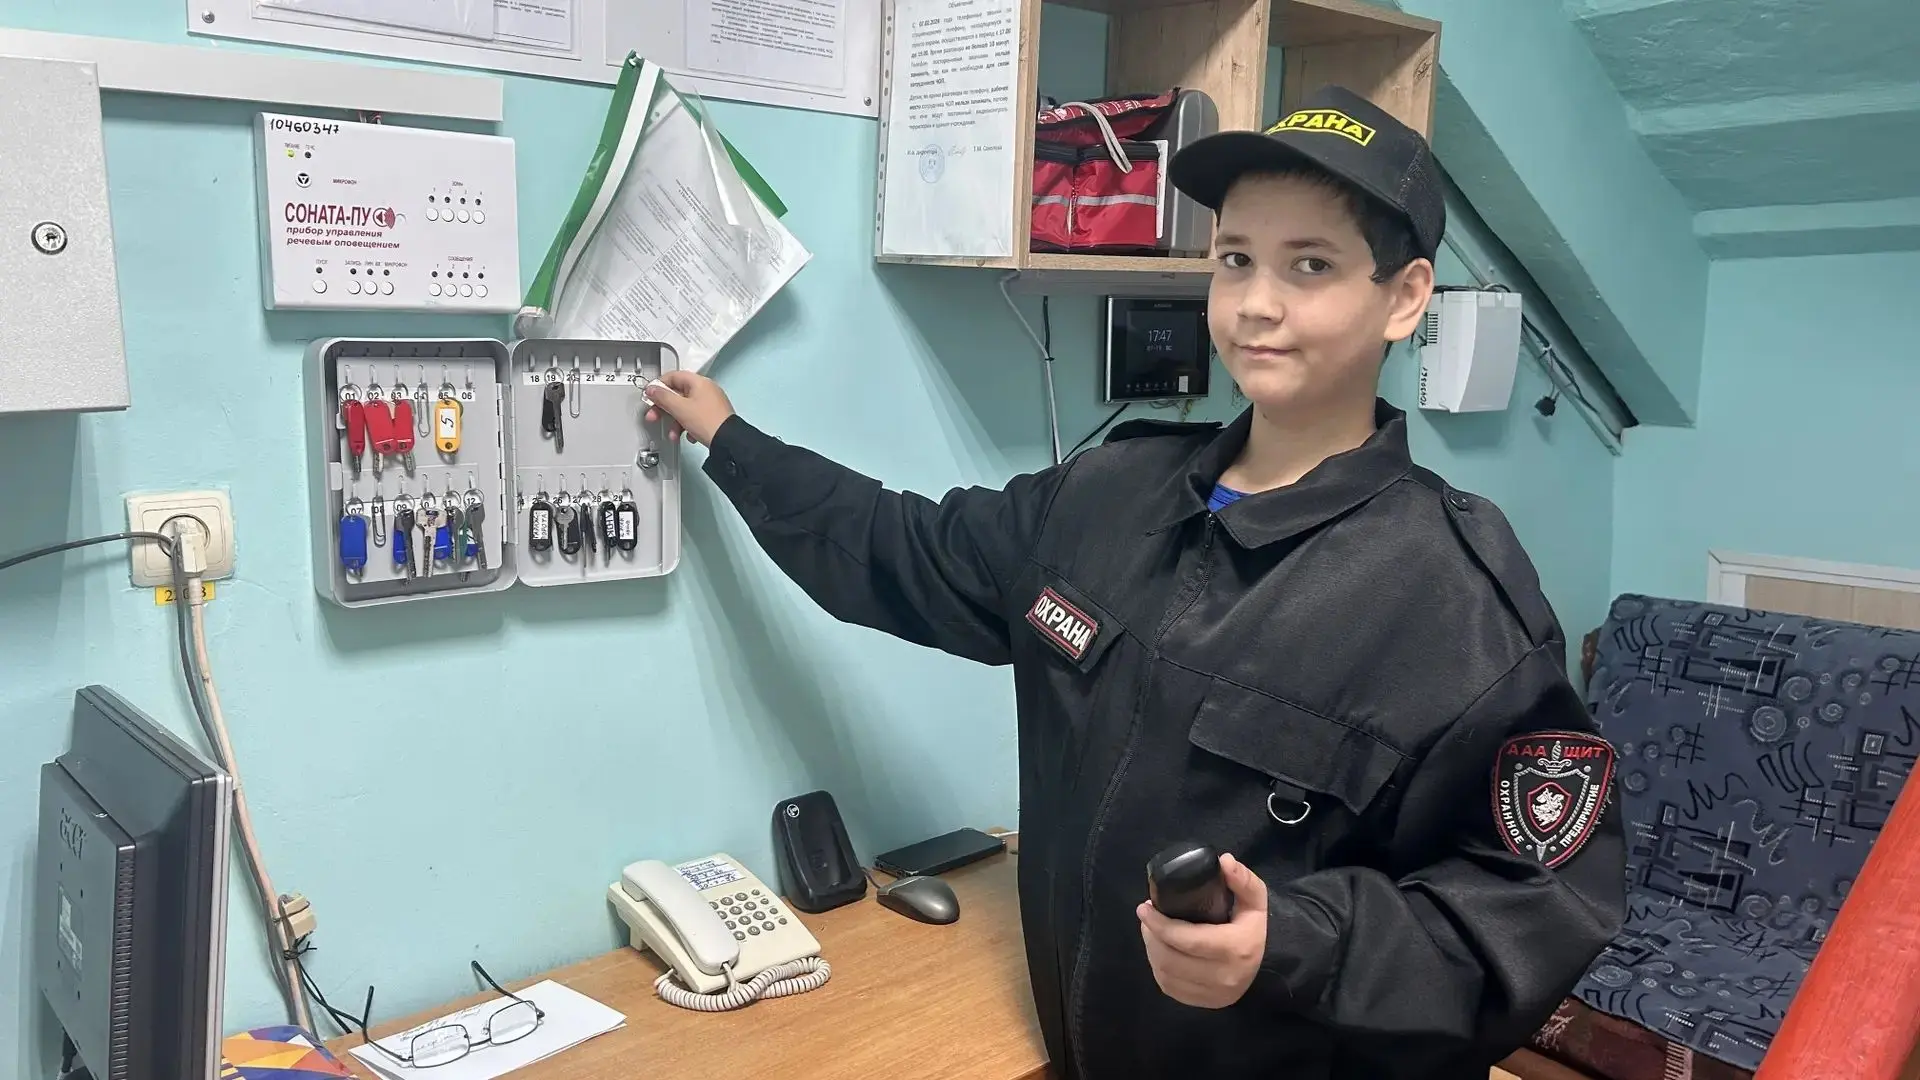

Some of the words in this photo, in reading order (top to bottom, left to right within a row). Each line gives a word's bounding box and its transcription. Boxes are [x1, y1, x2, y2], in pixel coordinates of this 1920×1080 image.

[270, 118, 339, 134] 10460347
[1279, 114, 1362, 138] РАНА
[285, 202, 372, 227] СОНАТА-ПУ
[286, 226, 323, 236] прибор
[326, 229, 383, 237] управления
[287, 238, 332, 246] речевым
[334, 240, 400, 249] оповещением
[1149, 330, 1172, 342] 17:47
[368, 392, 379, 400] 02
[438, 392, 449, 400] 05
[1035, 596, 1091, 651] ОХРАНА
[1507, 744, 1546, 757] ААА
[1563, 746, 1605, 760] ЩИТ
[1500, 780, 1524, 844] ОХРАННОЕ
[1559, 784, 1600, 848] ПРЕДПРИЯТИЕ
